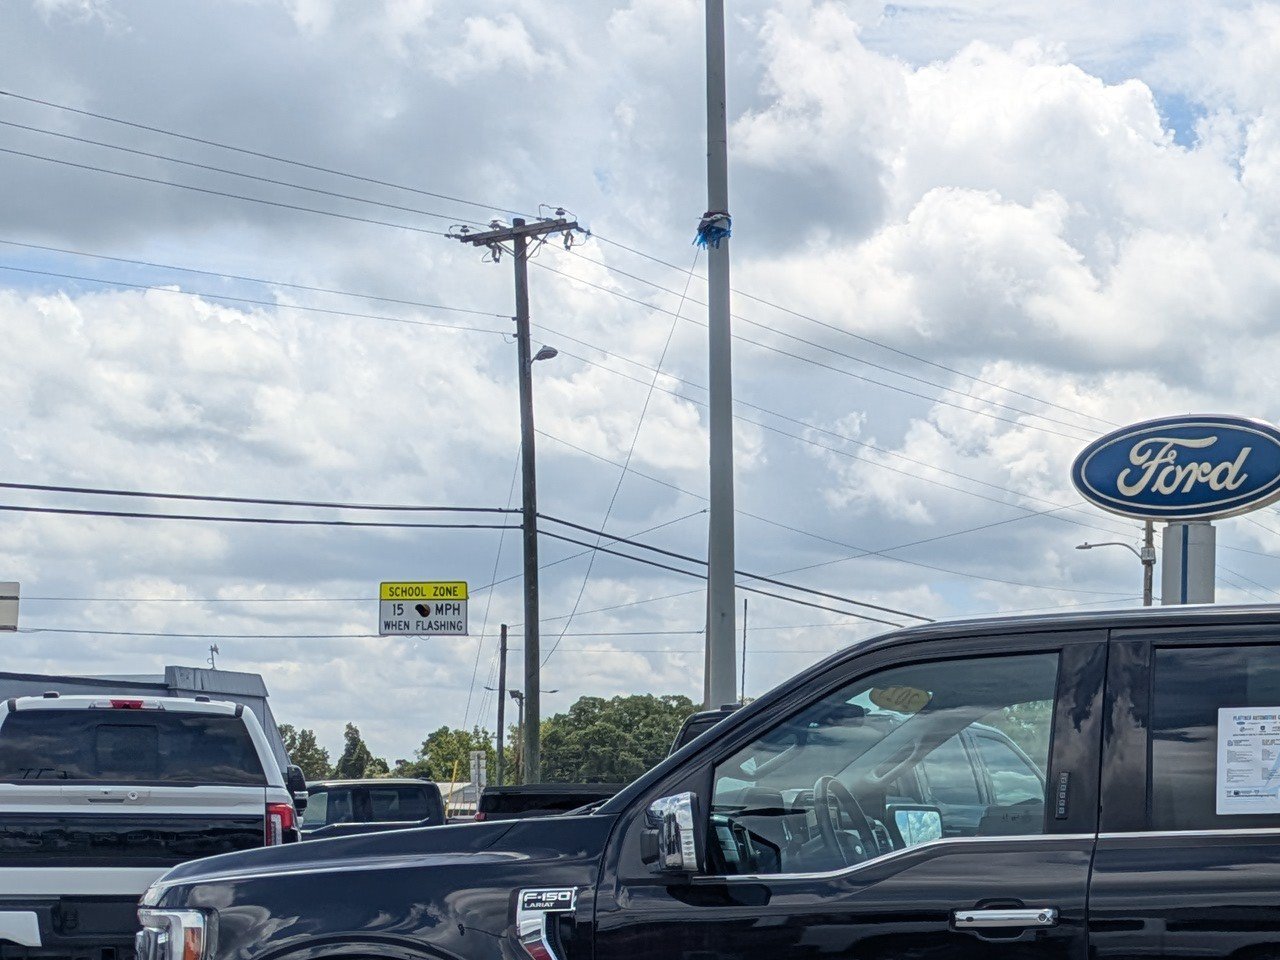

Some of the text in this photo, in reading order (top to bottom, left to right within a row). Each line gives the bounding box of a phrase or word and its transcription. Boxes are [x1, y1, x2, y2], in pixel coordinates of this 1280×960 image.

[1117, 436, 1251, 496] Ford
[389, 586, 458, 597] SCHOOL ZONE
[392, 603, 460, 616] 15 MPH
[383, 620, 463, 631] WHEN FLASHING
[523, 892, 571, 902] F-150
